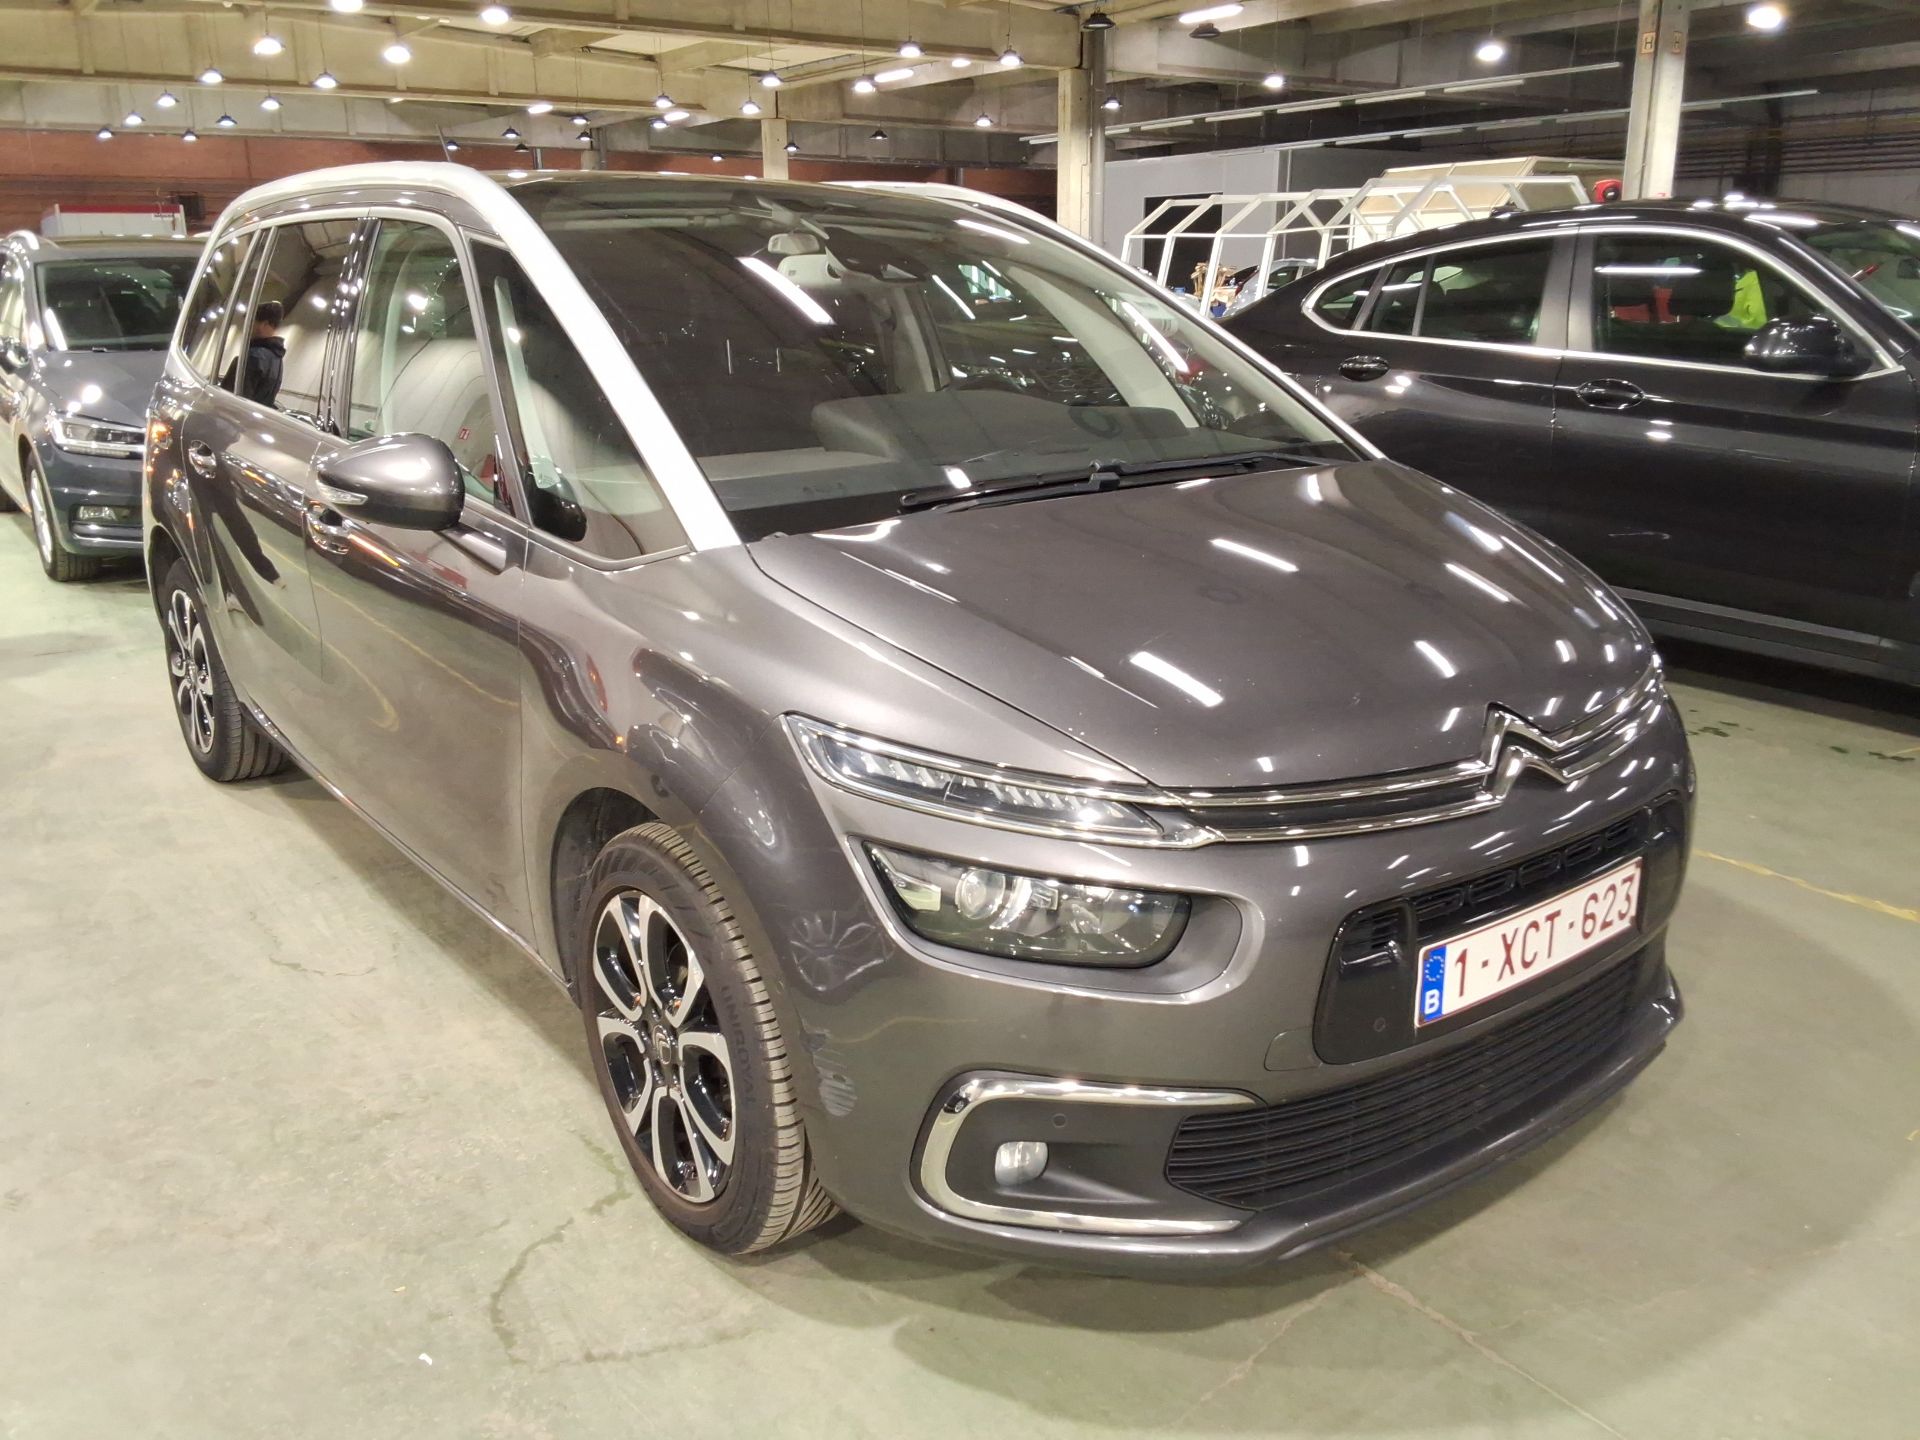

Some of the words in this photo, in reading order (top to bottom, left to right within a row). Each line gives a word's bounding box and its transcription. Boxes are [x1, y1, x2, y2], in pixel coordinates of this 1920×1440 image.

[1644, 36, 1654, 50] H
[1455, 876, 1636, 997] 1-XCT-623
[1424, 988, 1440, 1015] B
[720, 985, 757, 1102] UNIROYAL
